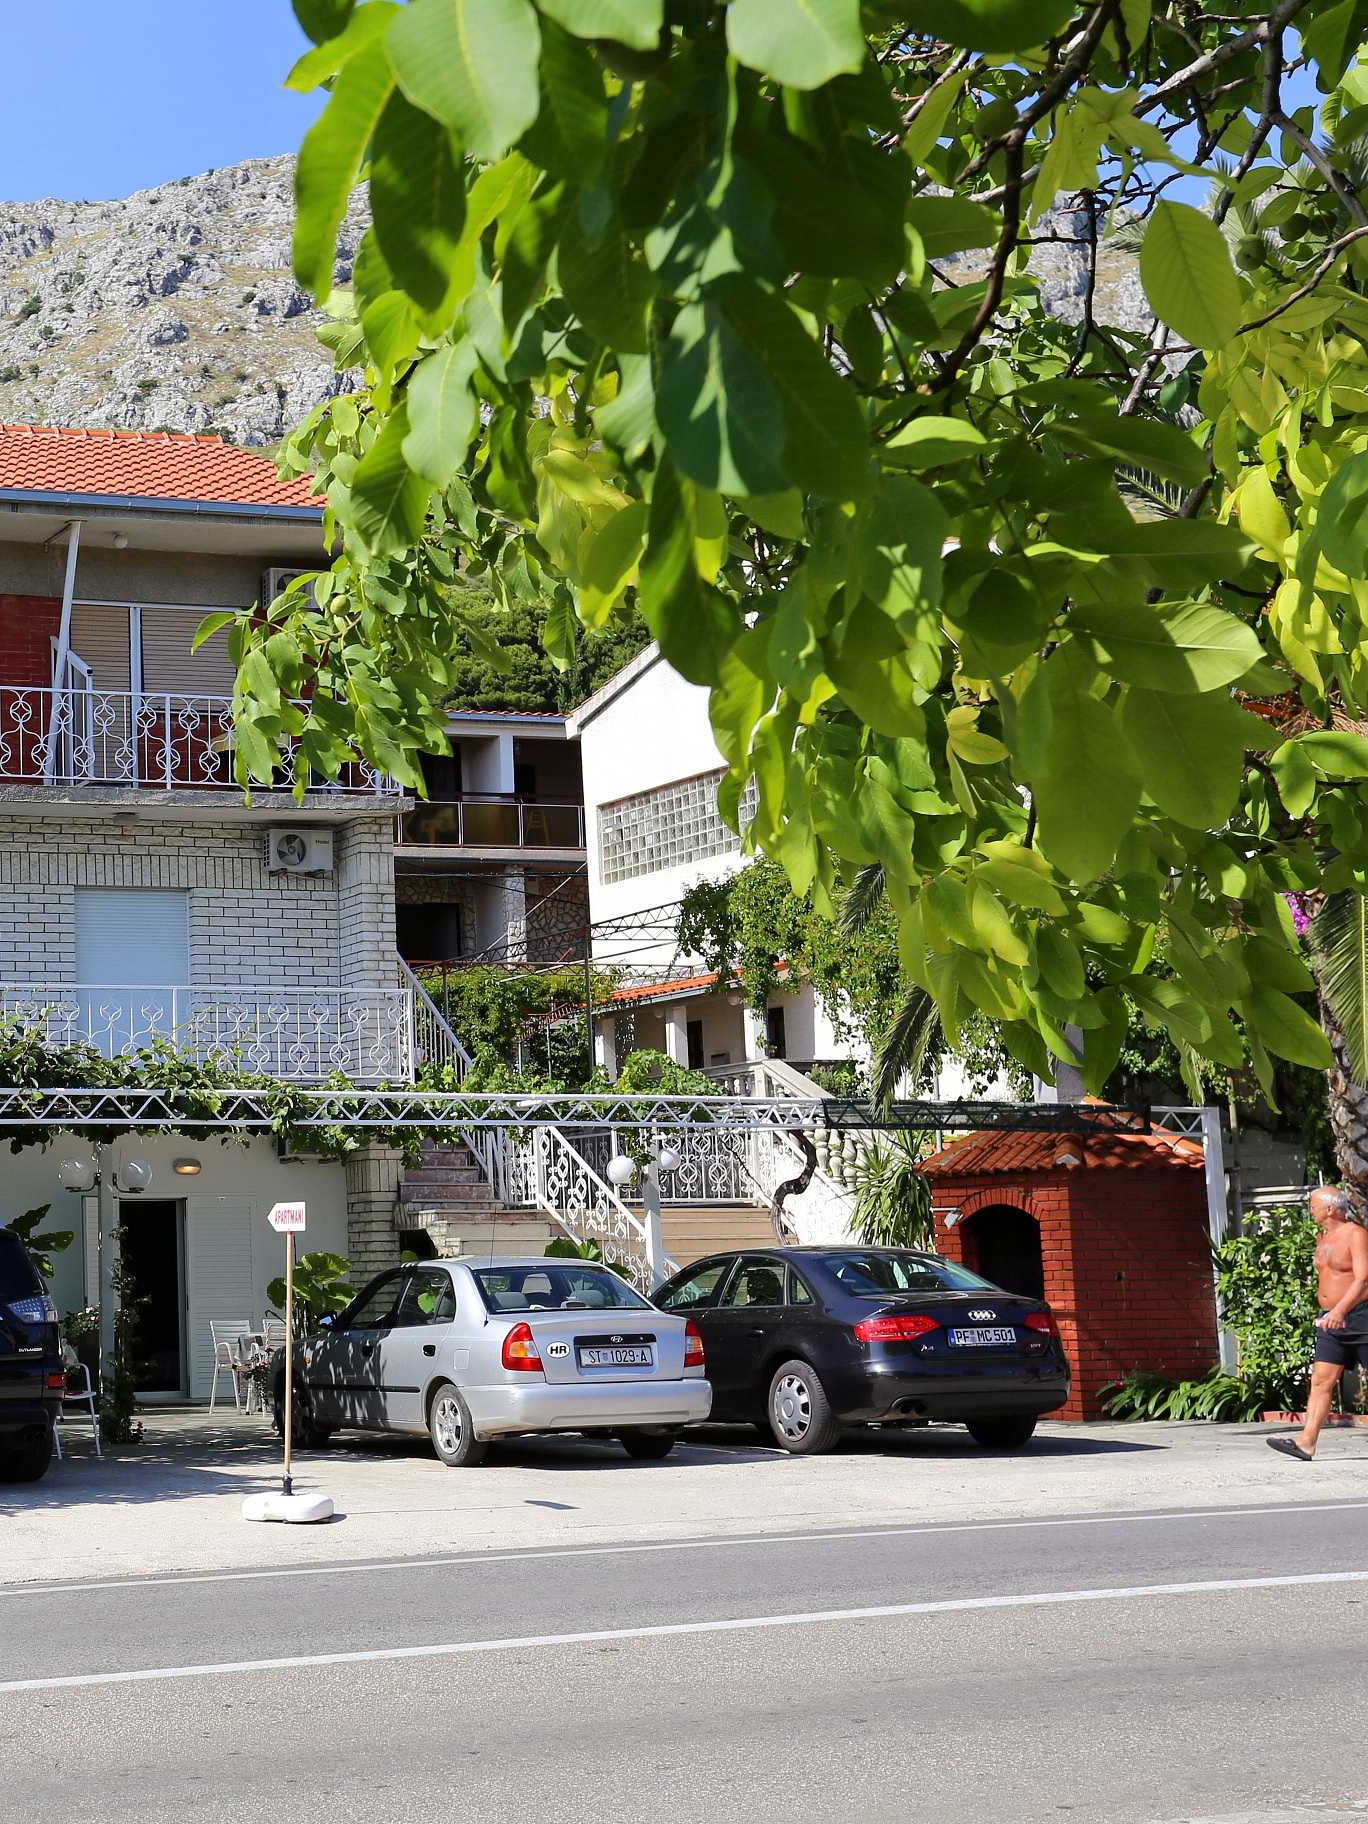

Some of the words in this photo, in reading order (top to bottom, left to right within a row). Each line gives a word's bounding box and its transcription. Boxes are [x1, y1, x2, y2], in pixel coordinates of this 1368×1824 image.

[275, 1209, 304, 1225] APARTMANI
[955, 1330, 970, 1342] PF
[976, 1330, 992, 1342] MC
[993, 1329, 1015, 1342] 501
[550, 1345, 567, 1354] HR
[588, 1350, 601, 1363] ST
[610, 1350, 647, 1363] 1029-A
